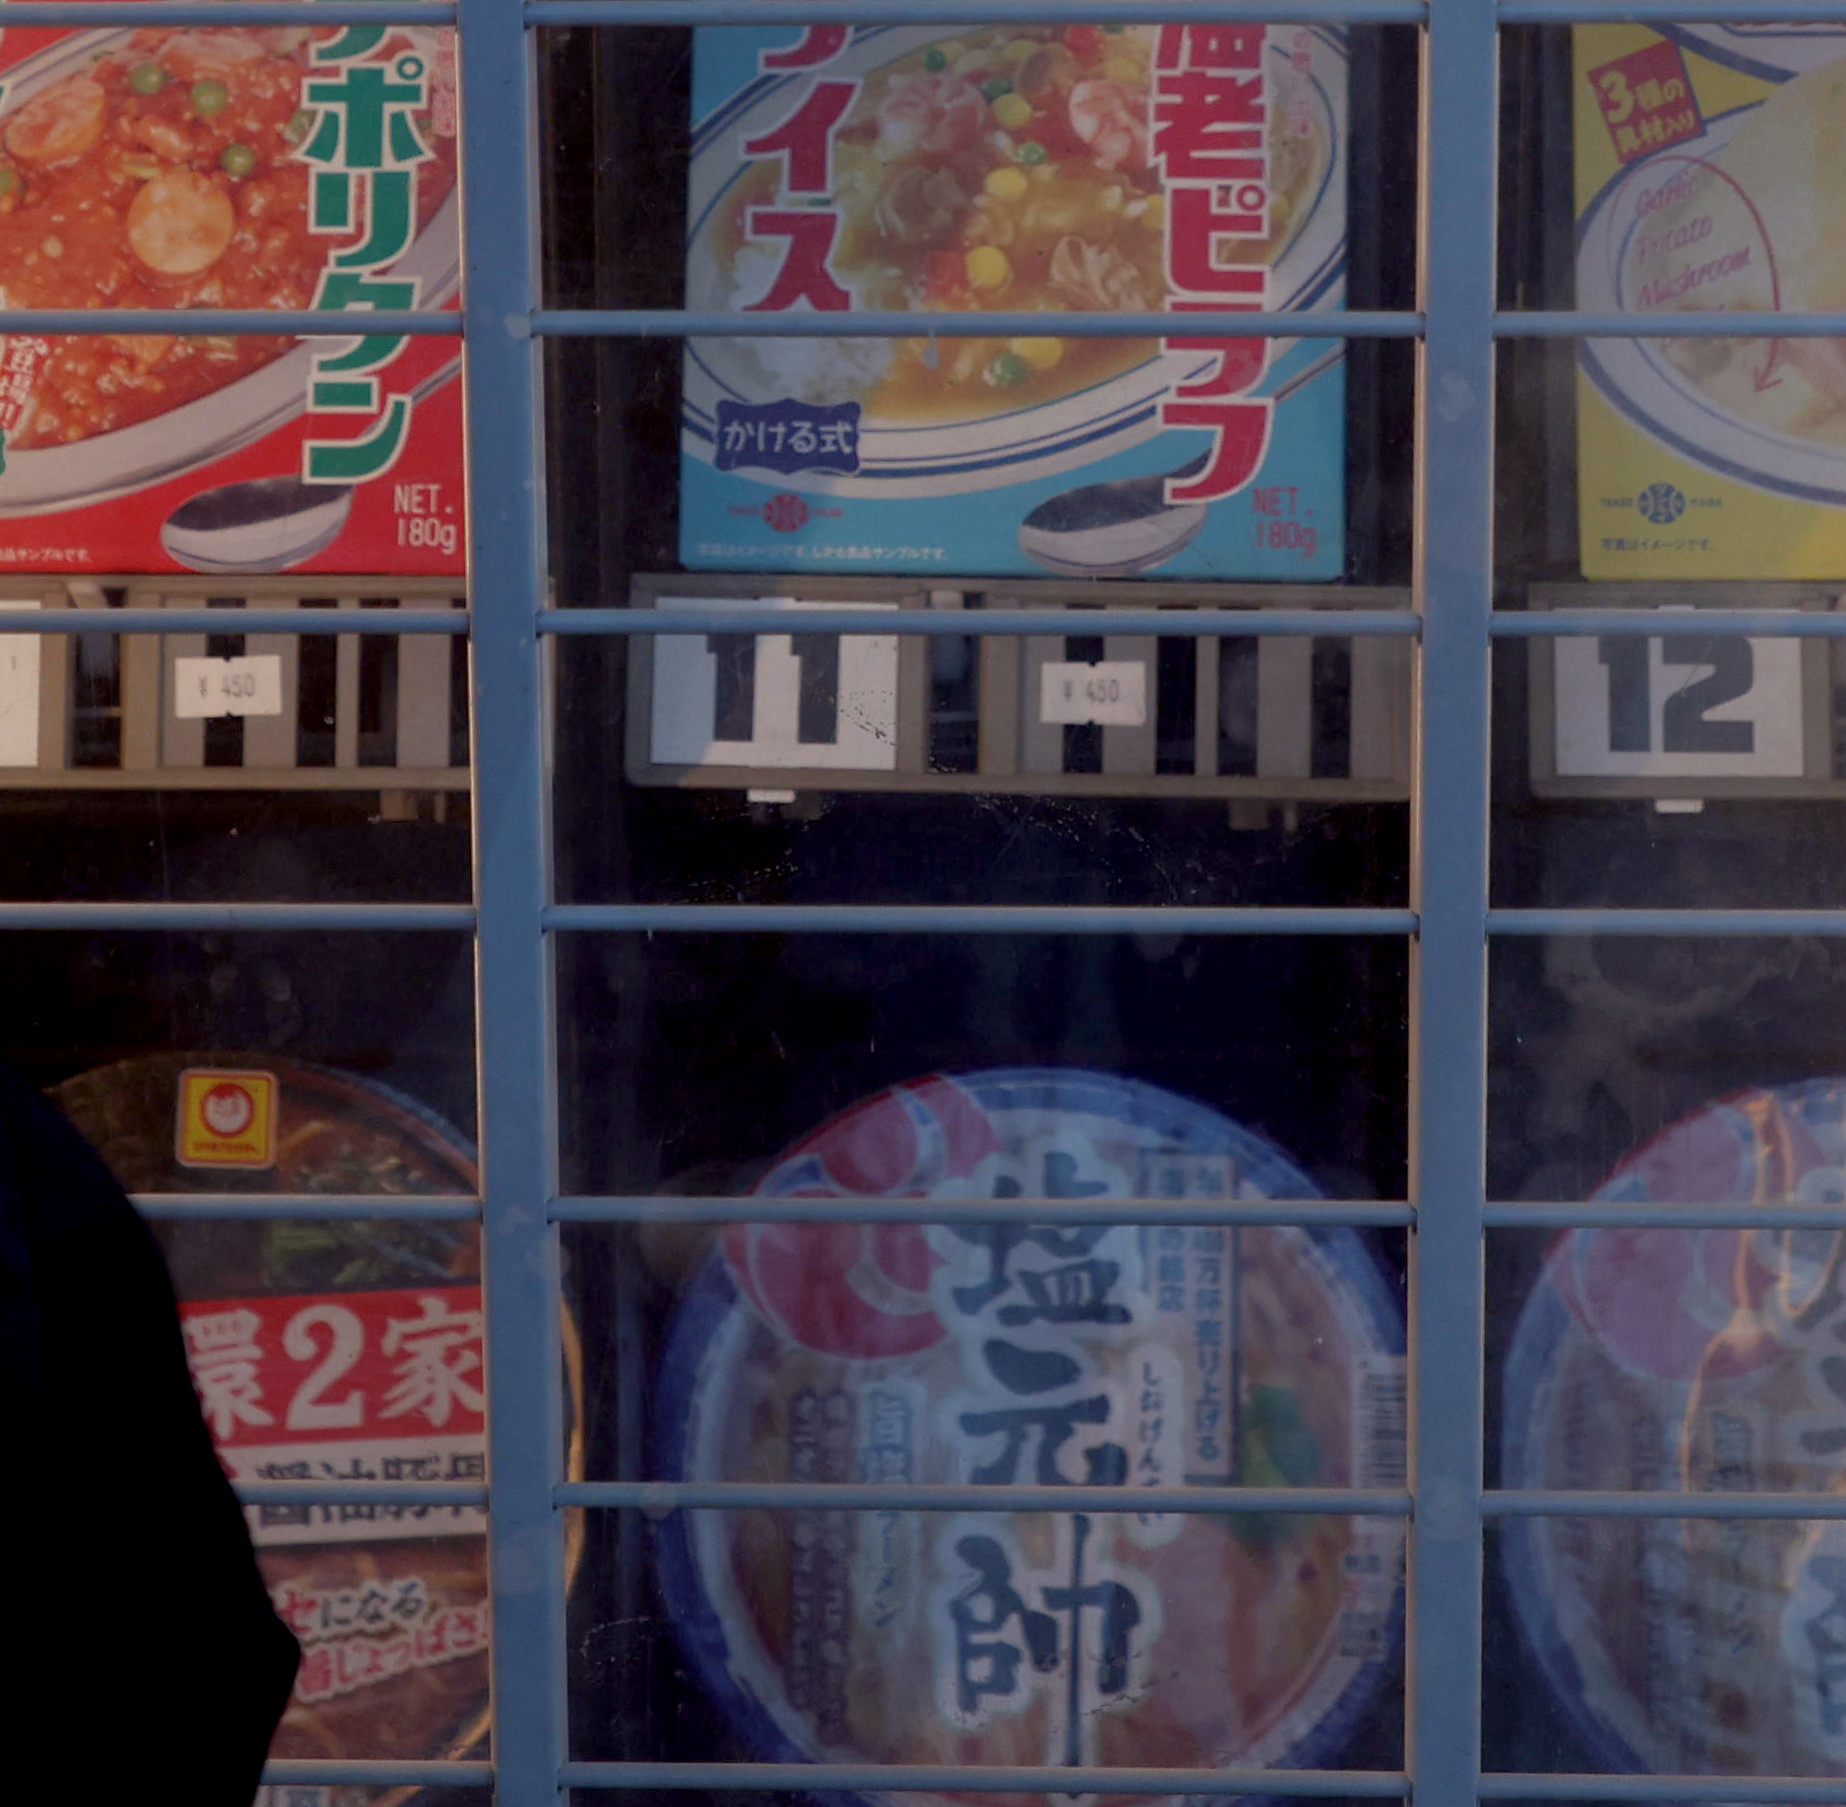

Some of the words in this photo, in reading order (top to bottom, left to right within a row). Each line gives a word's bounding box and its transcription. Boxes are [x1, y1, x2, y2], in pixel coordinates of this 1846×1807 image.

[724, 419, 853, 455] かける式
[394, 484, 453, 515] NET.
[397, 518, 458, 554] 180g
[1256, 520, 1317, 557] 180g
[706, 633, 839, 744] 11
[1598, 635, 1753, 753] 12
[951, 1151, 1143, 1797] 塩元帥
